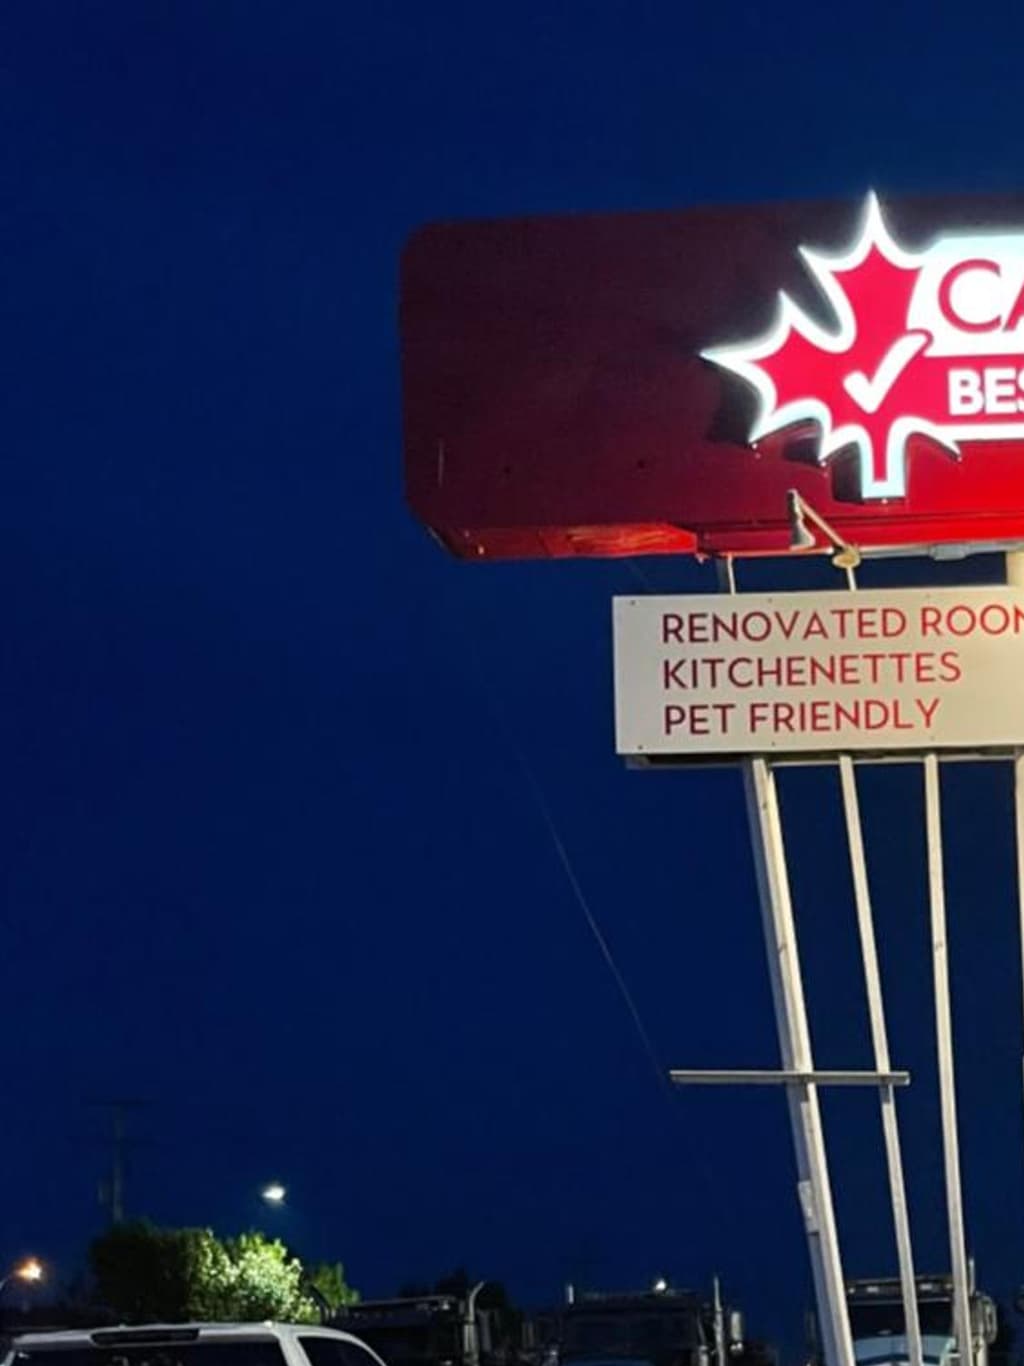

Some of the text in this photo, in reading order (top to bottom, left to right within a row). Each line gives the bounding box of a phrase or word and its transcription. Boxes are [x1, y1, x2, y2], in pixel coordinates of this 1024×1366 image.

[662, 606, 907, 644] RENOVATED
[662, 651, 962, 690] KITCHENETTES
[664, 697, 941, 736] PET FRIENDLY
